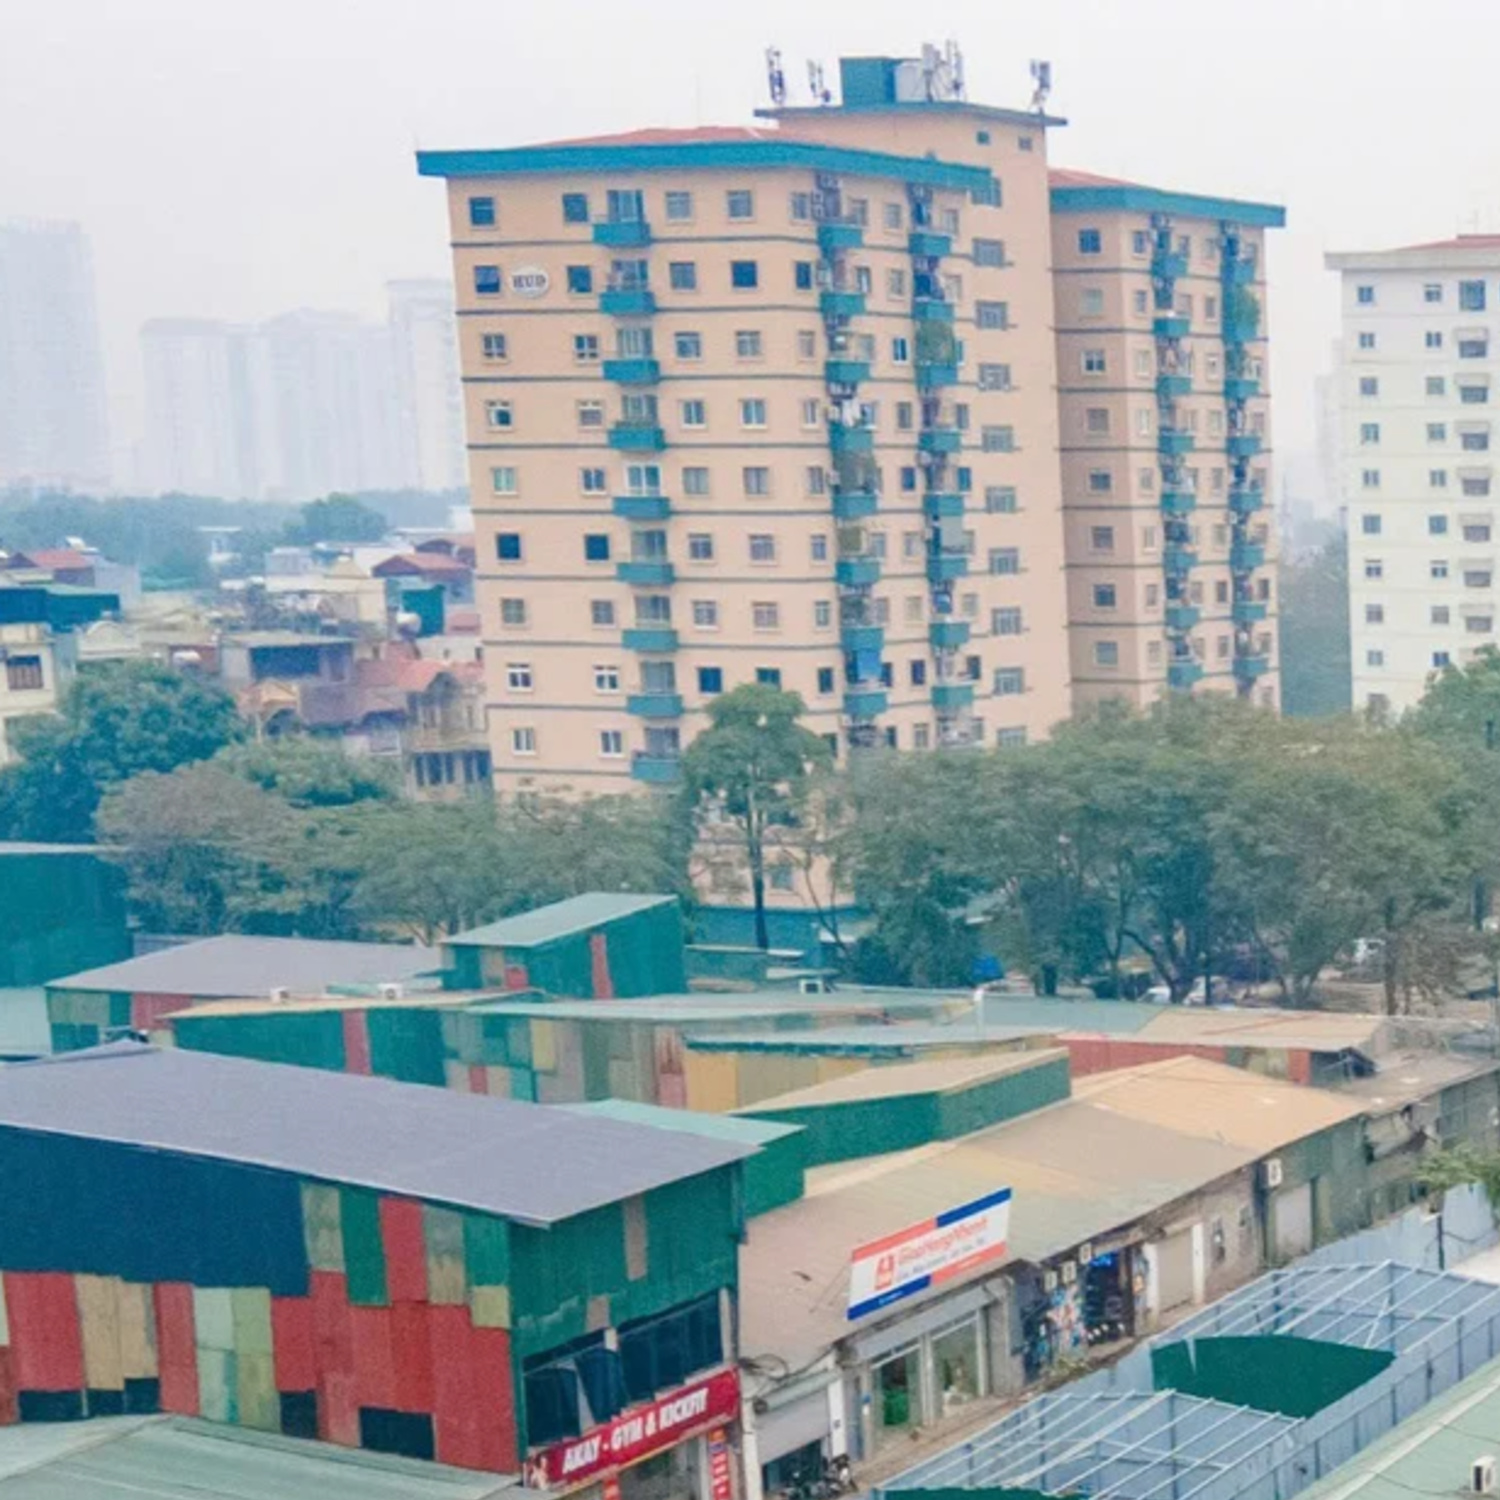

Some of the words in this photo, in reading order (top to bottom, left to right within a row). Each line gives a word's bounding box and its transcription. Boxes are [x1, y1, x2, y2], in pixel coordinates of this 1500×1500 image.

[562, 1435, 601, 1474] AKAY
[611, 1416, 643, 1450] GYM
[645, 1411, 656, 1436] &
